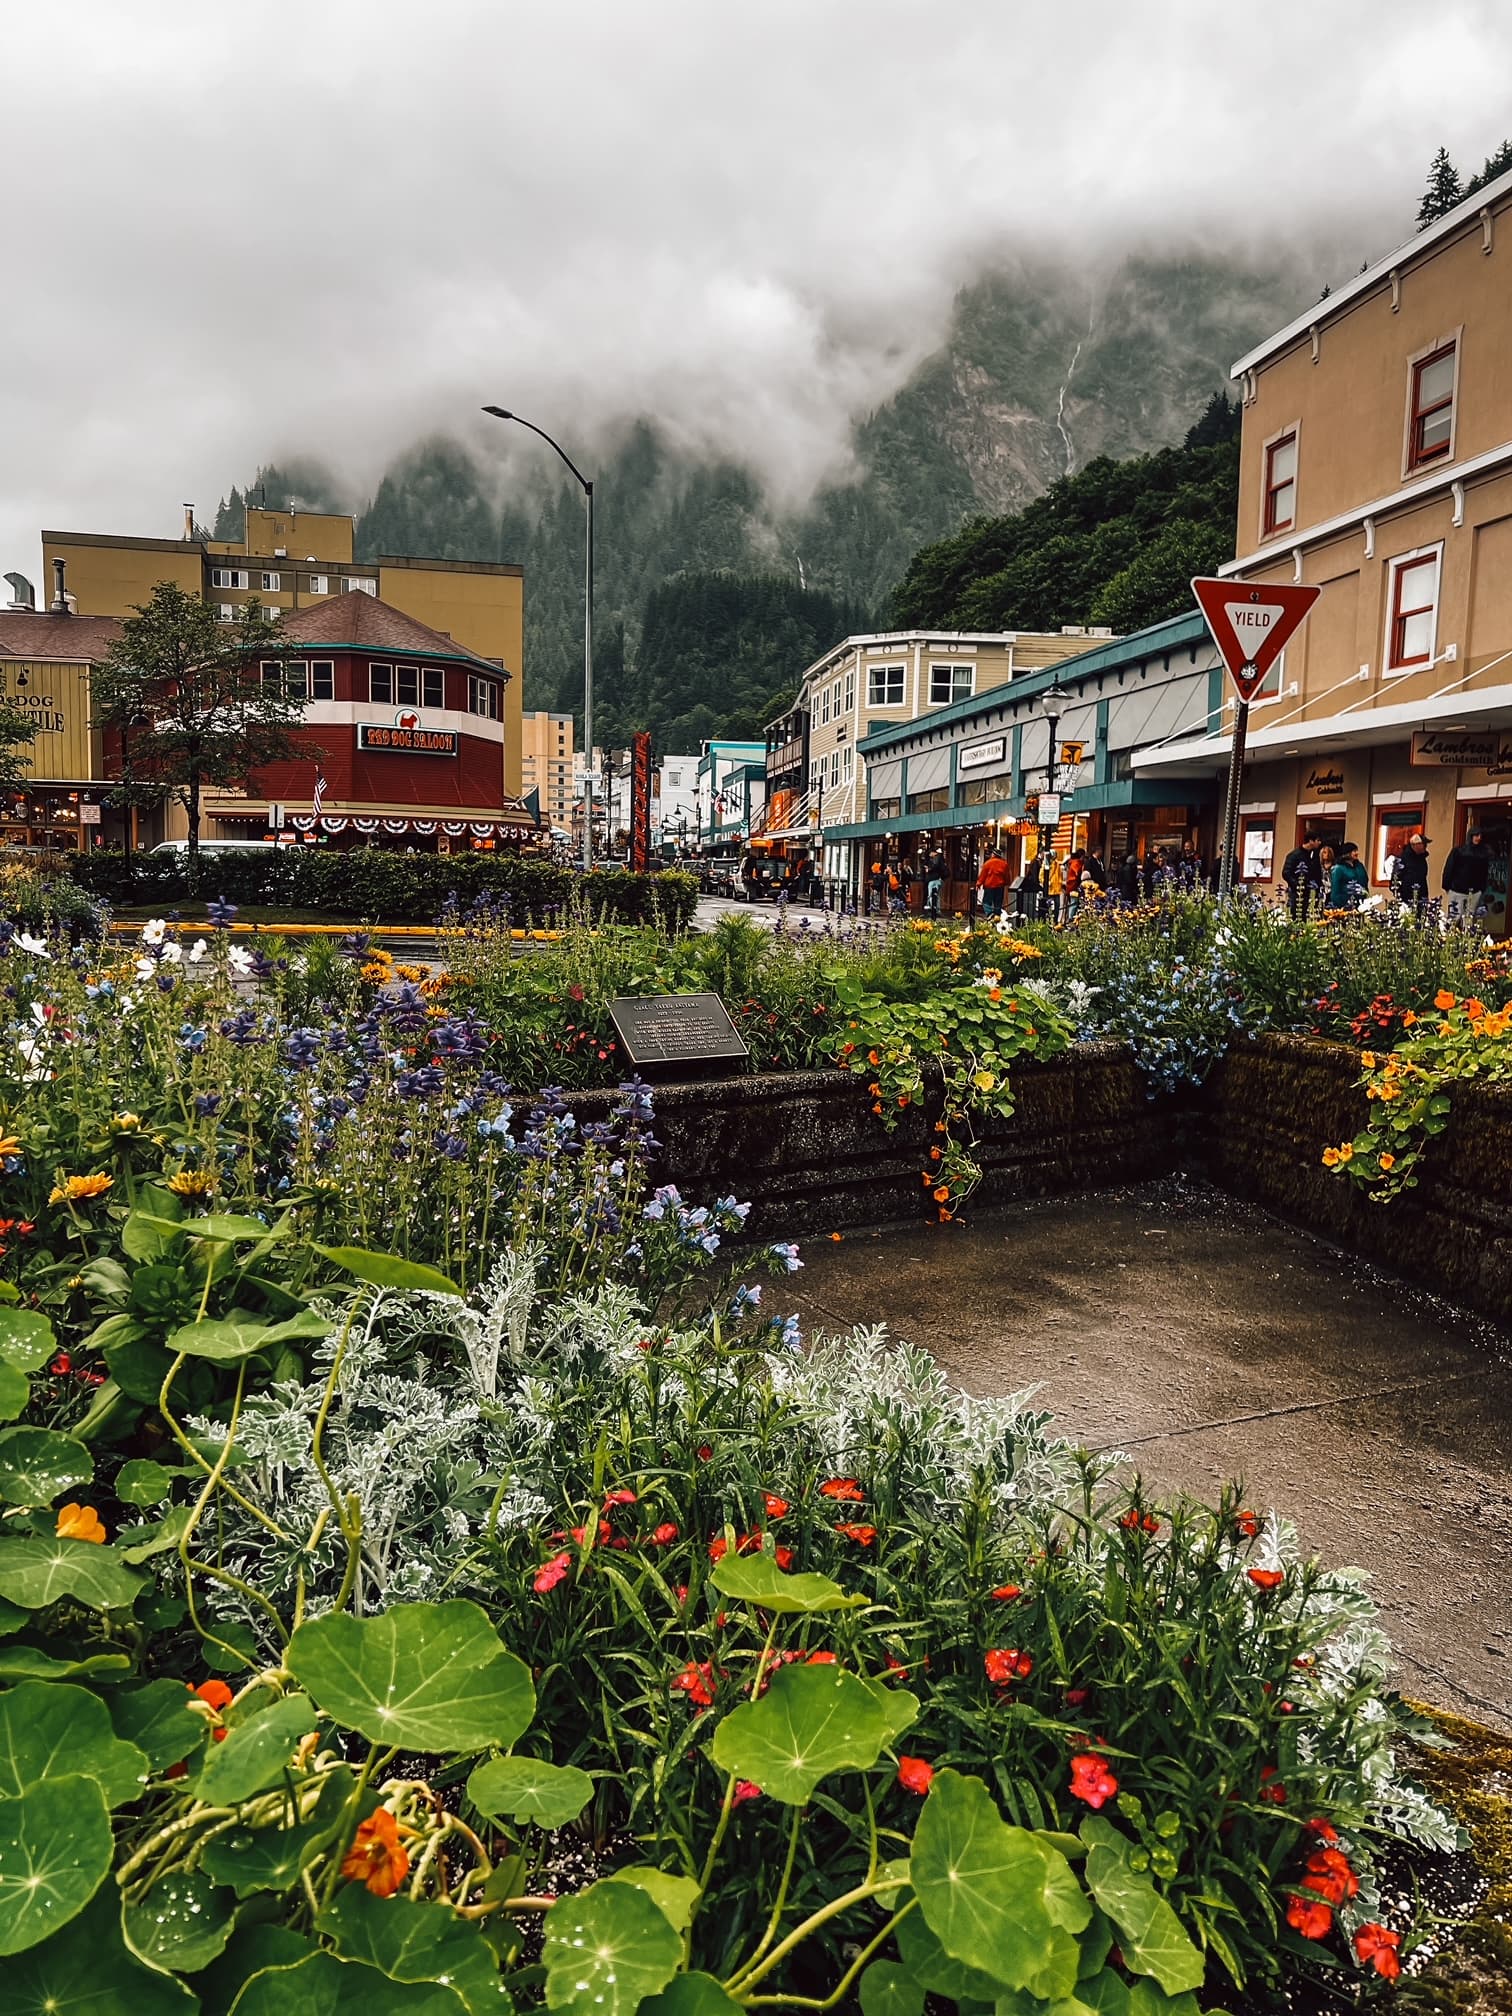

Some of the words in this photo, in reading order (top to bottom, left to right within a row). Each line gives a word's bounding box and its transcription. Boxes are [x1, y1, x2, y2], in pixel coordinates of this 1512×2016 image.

[1235, 611, 1270, 627] YIELD
[15, 695, 54, 707] DOG
[367, 728, 390, 746] RED
[391, 730, 412, 747] DOG
[413, 731, 453, 751] SALOON
[1417, 735, 1495, 754] Lambros
[1440, 754, 1494, 765] Goldsmith
